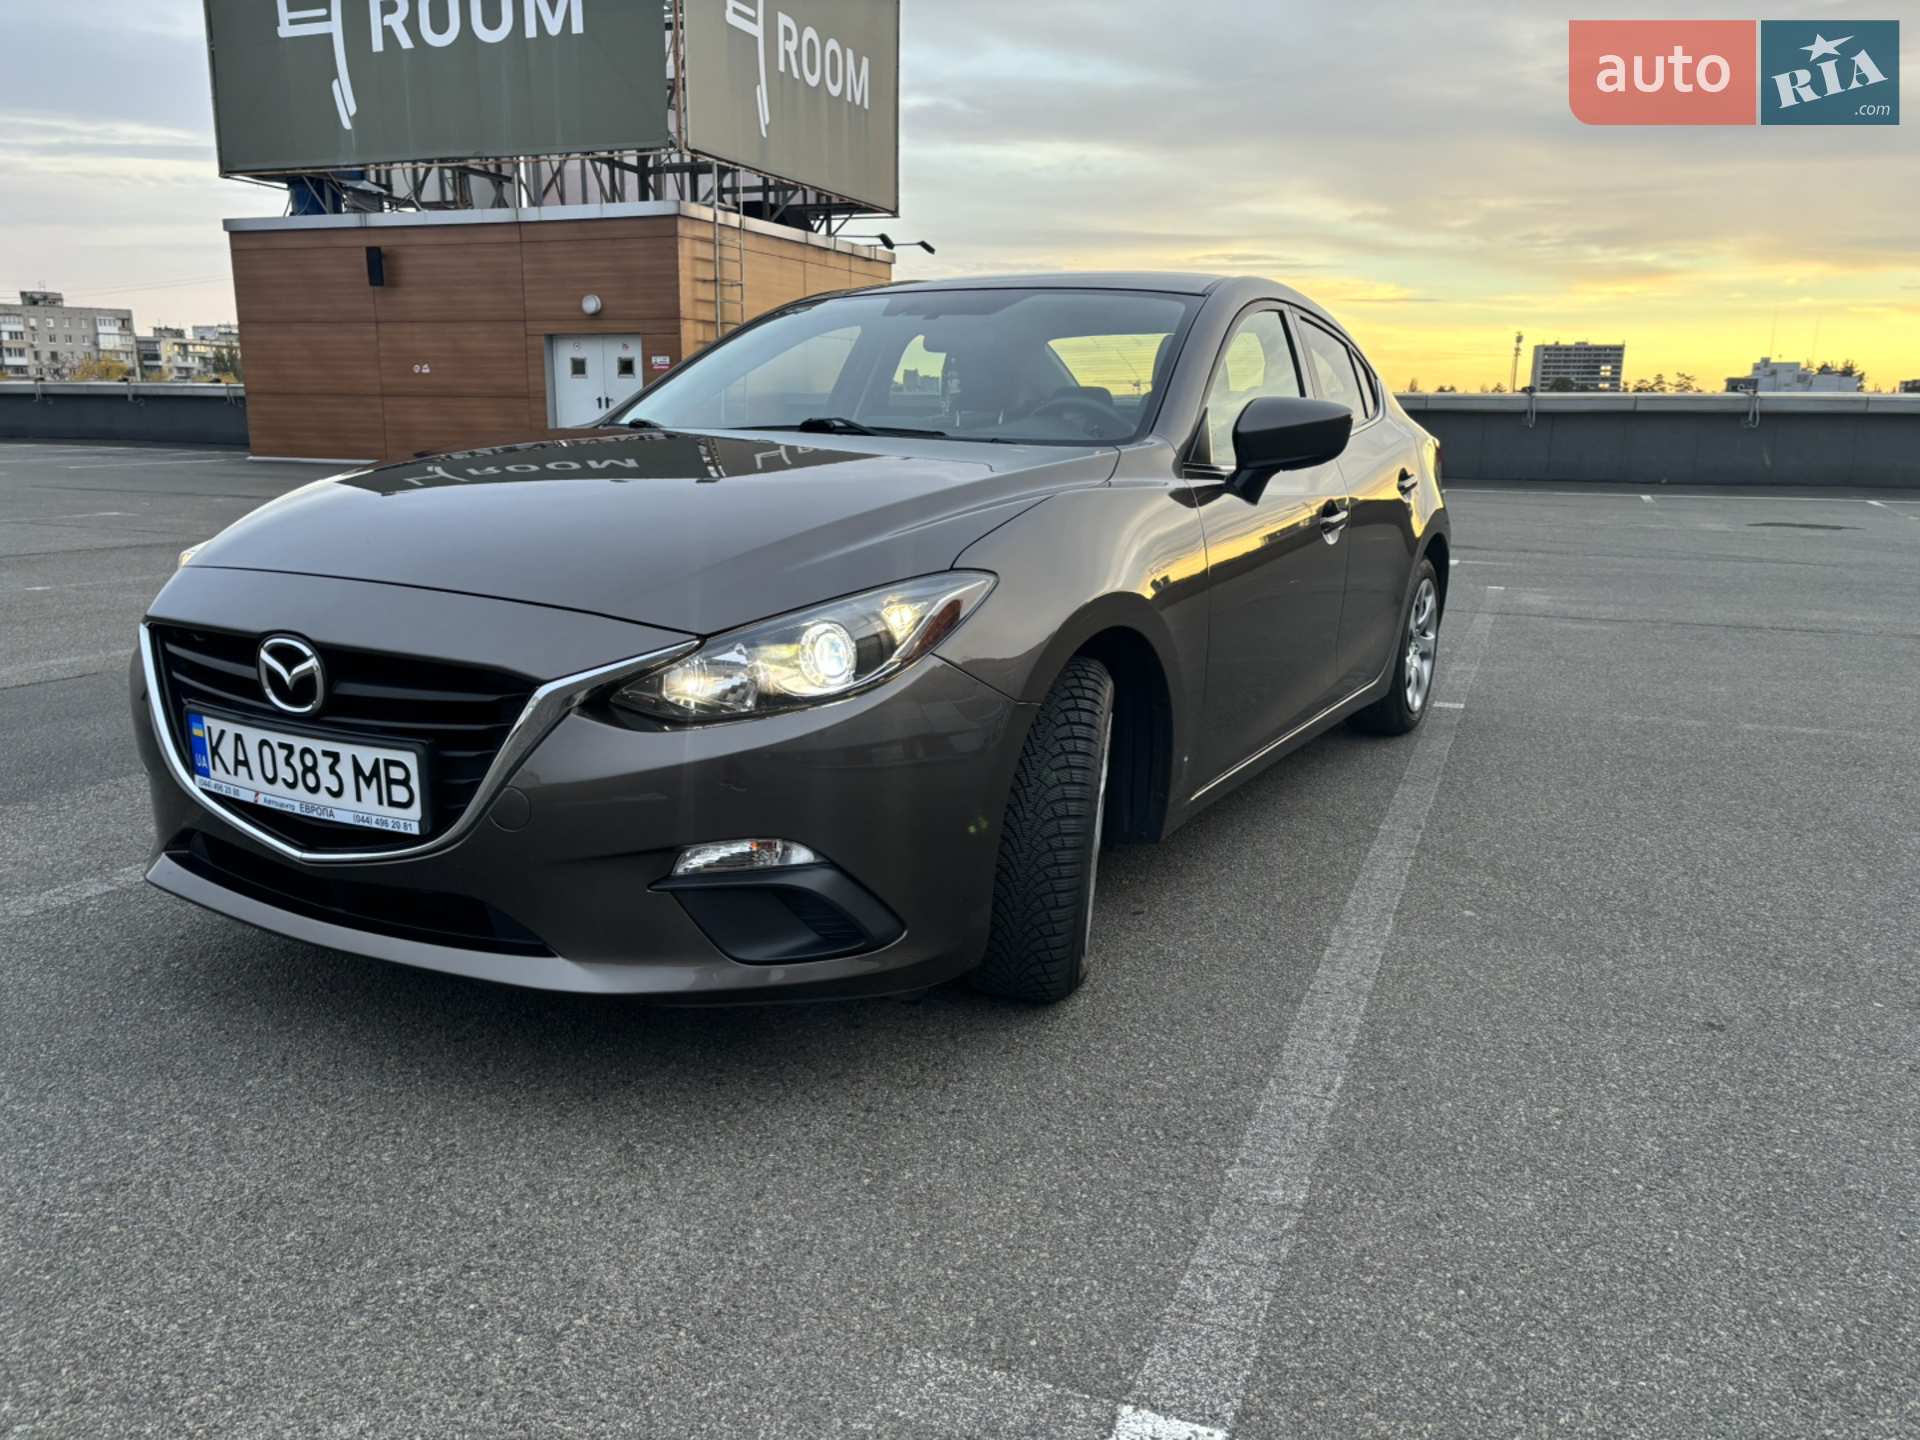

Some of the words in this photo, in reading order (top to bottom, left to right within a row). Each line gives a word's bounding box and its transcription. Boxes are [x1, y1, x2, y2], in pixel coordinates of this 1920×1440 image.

[195, 753, 208, 769] UA
[299, 803, 335, 819] ЕВРОПА
[353, 813, 373, 826] (044)
